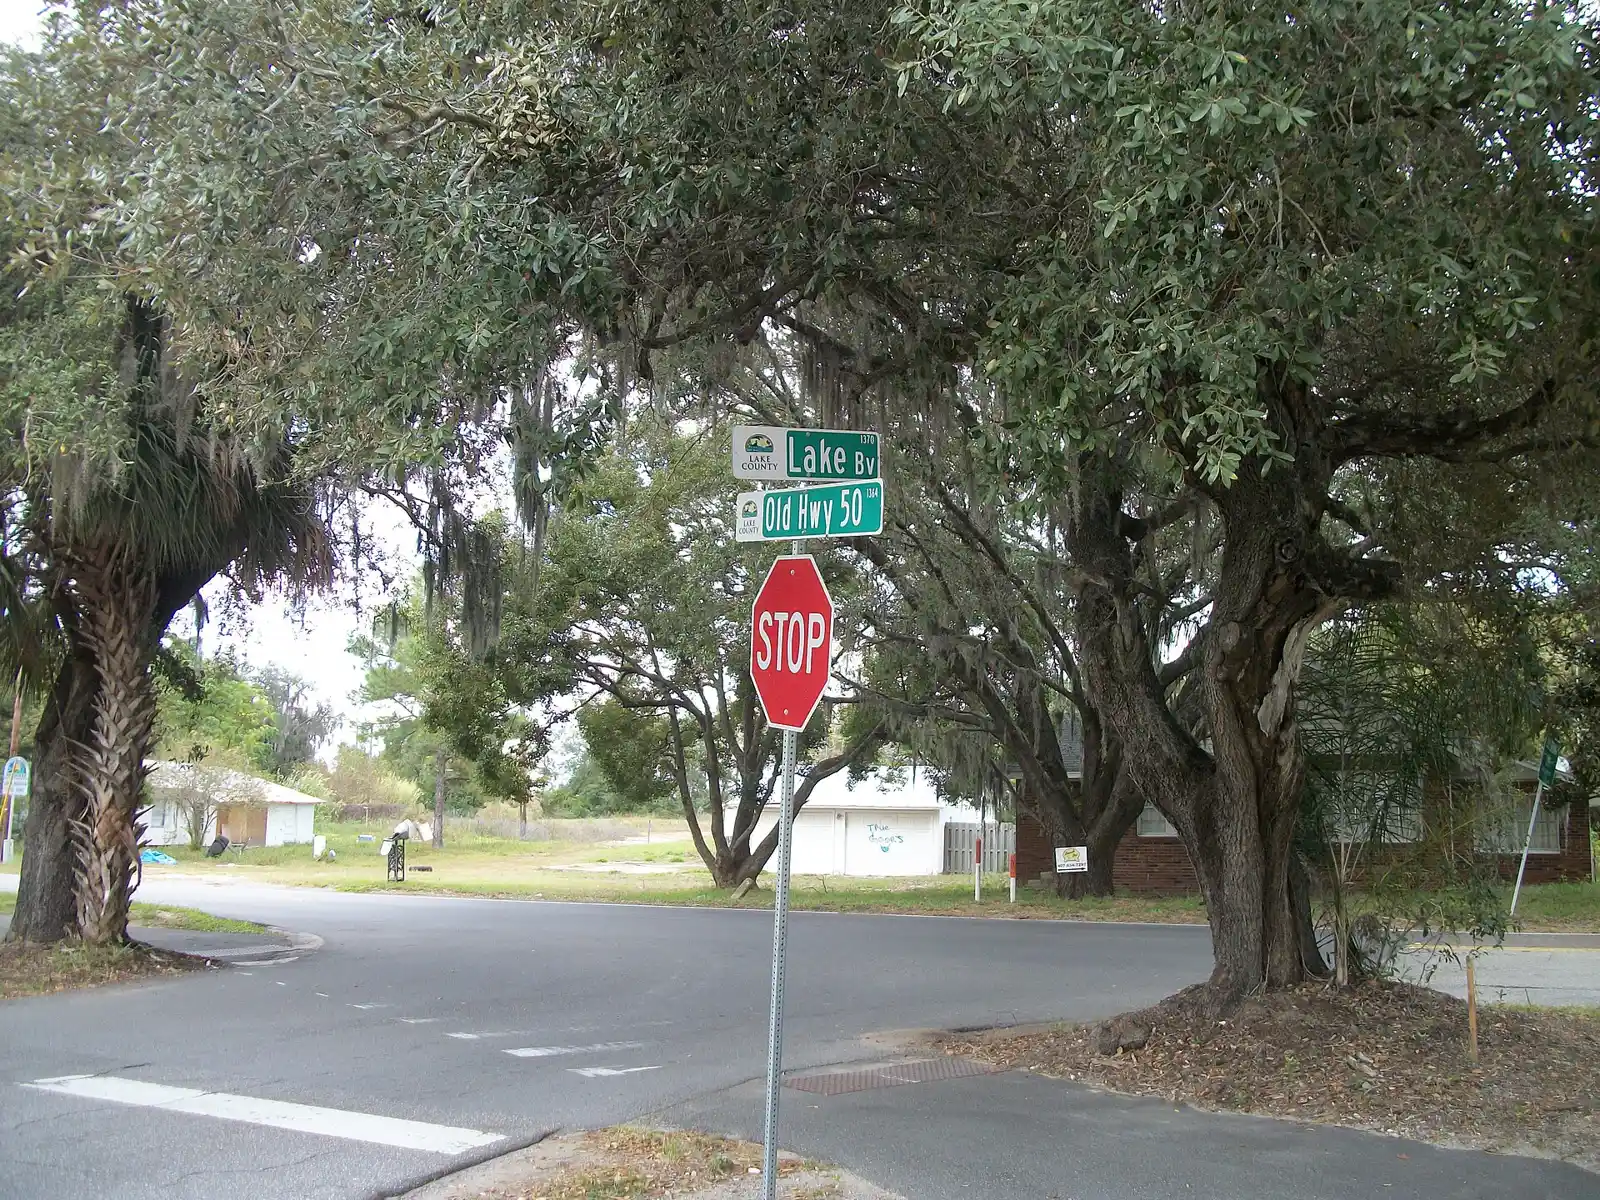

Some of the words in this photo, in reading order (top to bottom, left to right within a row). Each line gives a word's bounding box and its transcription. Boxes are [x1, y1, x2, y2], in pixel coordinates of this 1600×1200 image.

[860, 434, 875, 444] 1370
[749, 455, 771, 463] LAKE
[788, 436, 846, 474] Lake
[855, 451, 875, 475] Bv
[741, 463, 778, 471] COUNTY
[765, 495, 791, 532] Old
[798, 493, 833, 536] Hwy
[840, 488, 863, 528] 50
[743, 519, 756, 527] LAKE
[738, 527, 759, 535] COUNTY
[756, 610, 826, 674] STOP
